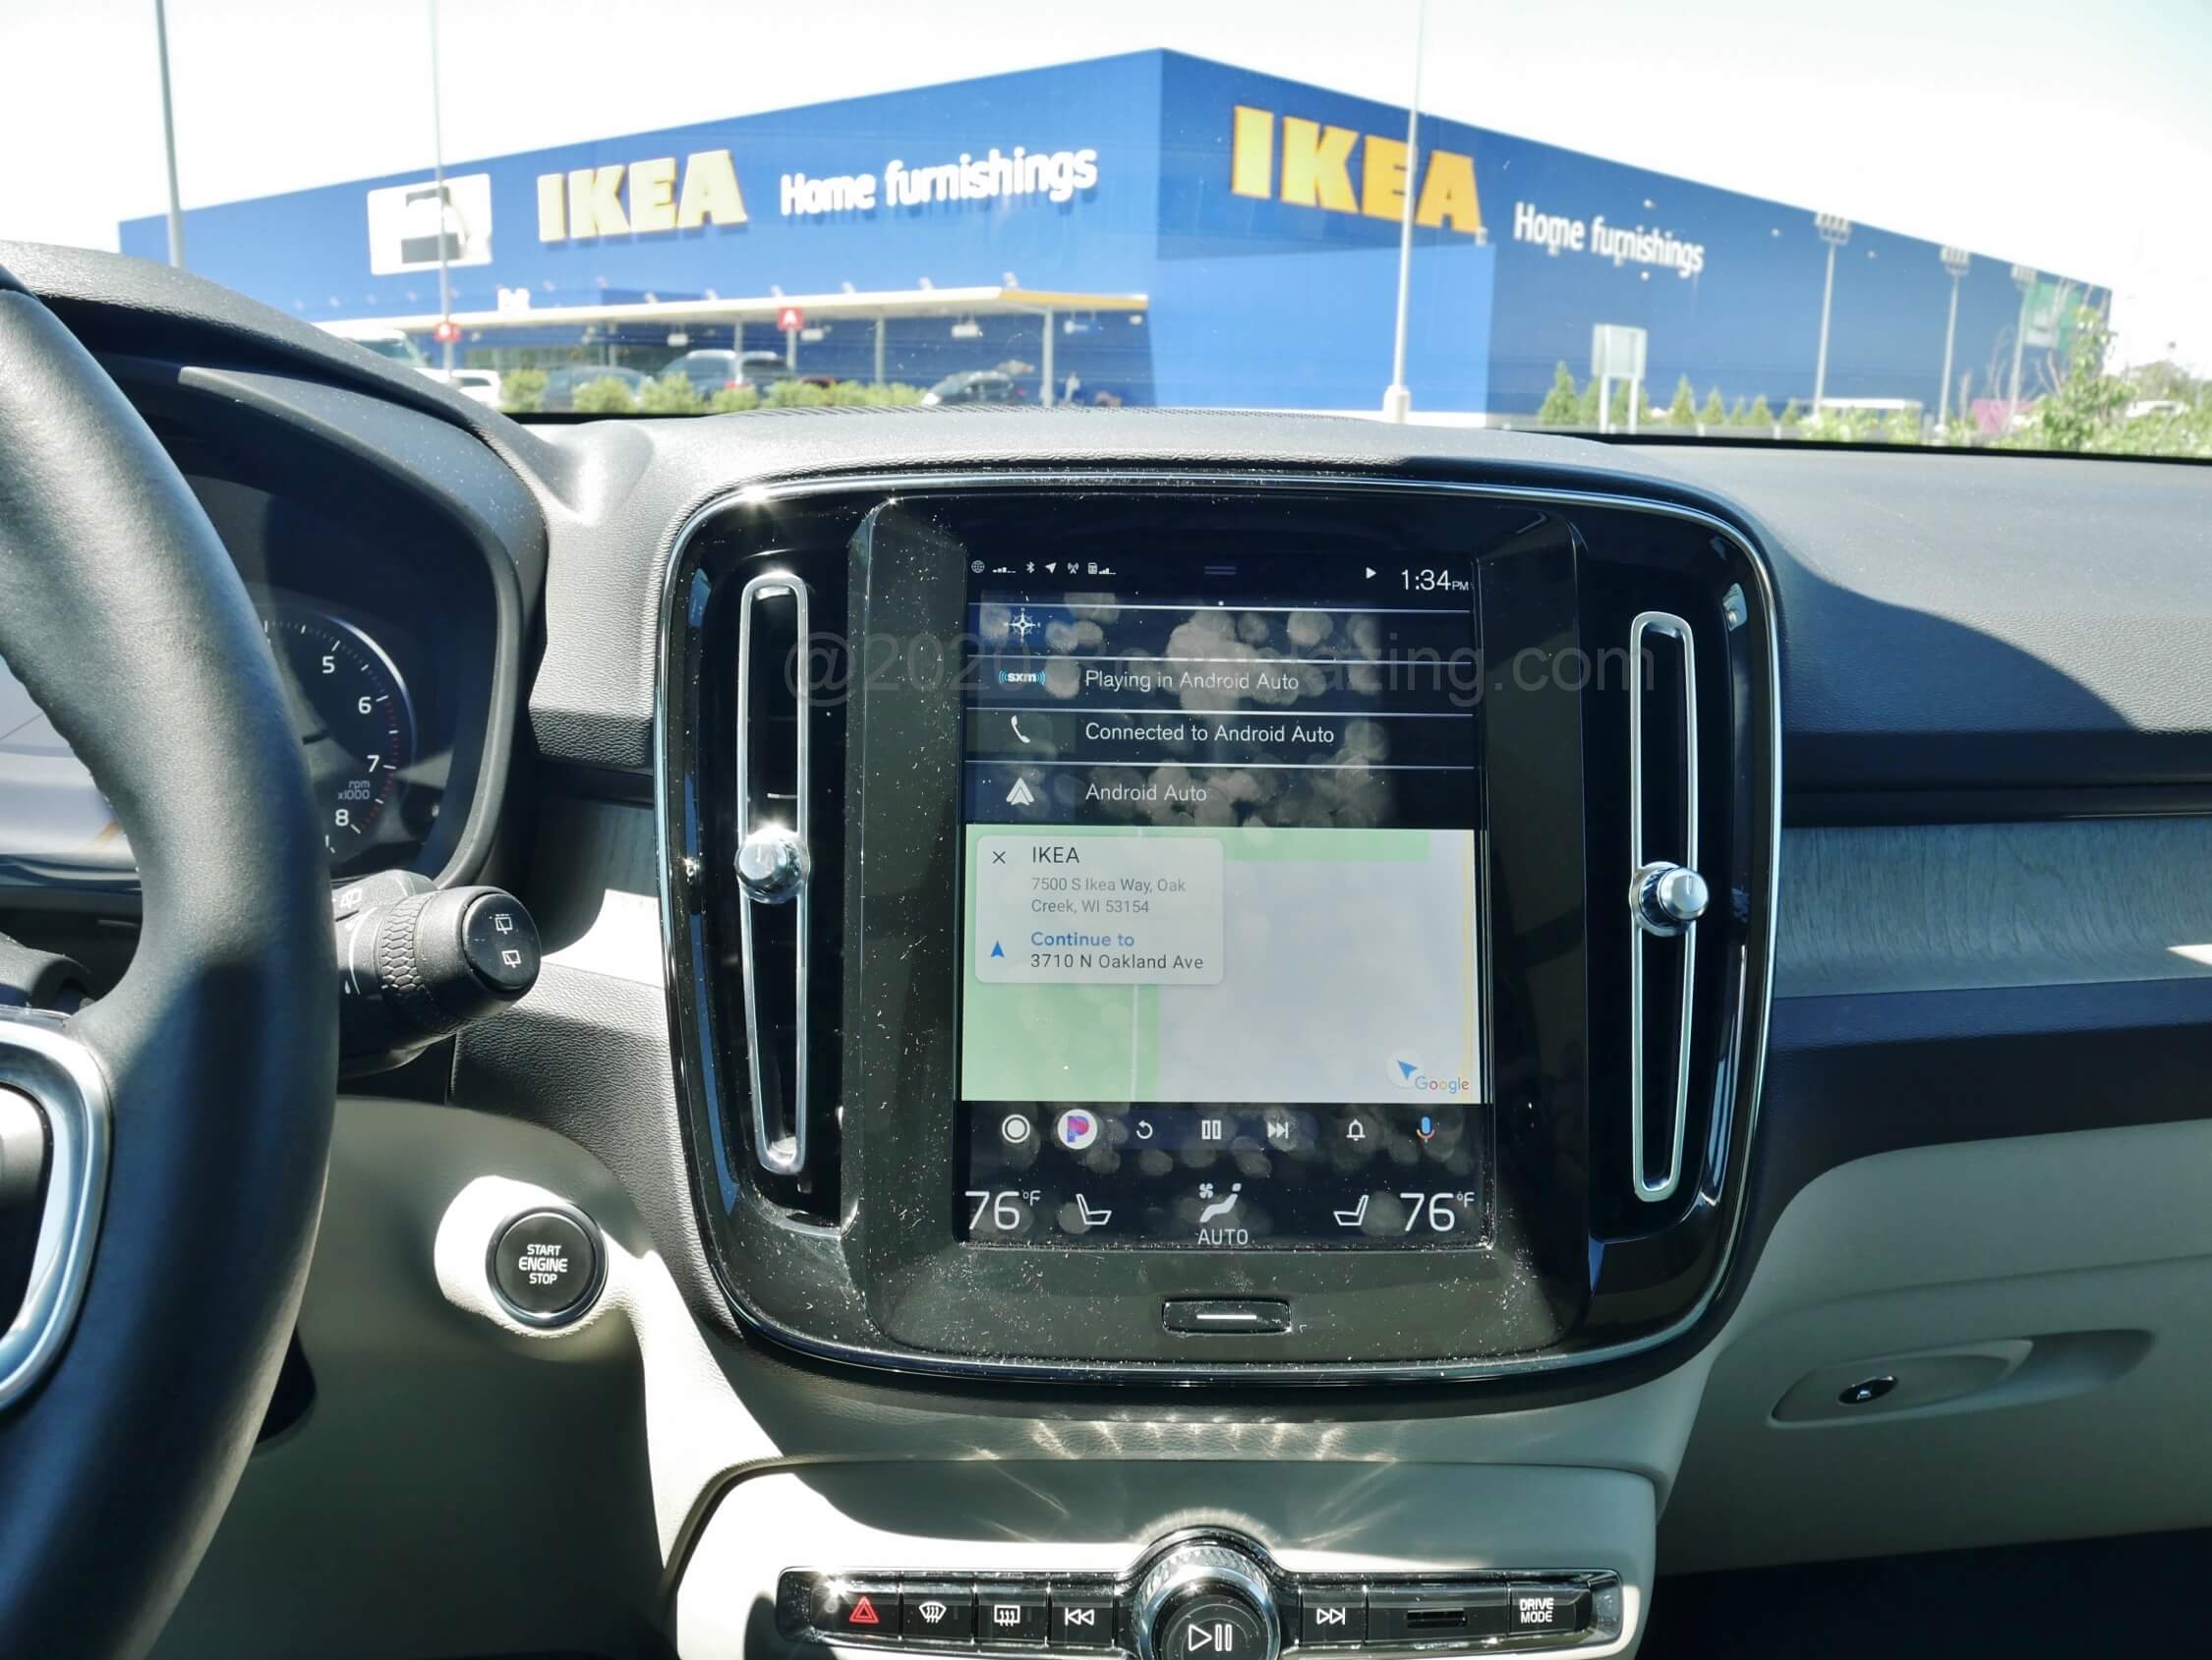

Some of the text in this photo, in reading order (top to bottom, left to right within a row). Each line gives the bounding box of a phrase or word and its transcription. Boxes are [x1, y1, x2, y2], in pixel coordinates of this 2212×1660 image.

[1233, 105, 1482, 234] IKEA
[780, 146, 1098, 216] Home furnishings
[538, 149, 747, 242] IKEA
[1513, 201, 1706, 279] Home furnishings
[321, 656, 335, 674] 5
[1007, 672, 1037, 682] sxm
[1085, 670, 1300, 691] Playing in Android Auto
[358, 696, 373, 715] 6
[1085, 723, 1335, 744] Connected to Android Auto
[367, 754, 380, 773] 7
[348, 779, 371, 790] rpm
[1085, 784, 1207, 802] Android Auto
[337, 790, 371, 800] x1000
[334, 808, 350, 827] 8
[1032, 846, 1079, 863] IKEA
[1031, 877, 1186, 893] 7500 S Ikea Way, Oak
[1031, 899, 1149, 916] Creek, WI 53154
[1030, 932, 1135, 947] Continue to
[1030, 954, 1203, 970] 3710 N Oakland Ave
[1414, 1075, 1470, 1093] Google
[1197, 1229, 1249, 1245] AUTO
[527, 1244, 561, 1256] START
[519, 1257, 568, 1272] ENGINE
[529, 1273, 557, 1285] STOP
[1519, 1597, 1554, 1611] DRIVE
[1520, 1611, 1553, 1624] MODE
